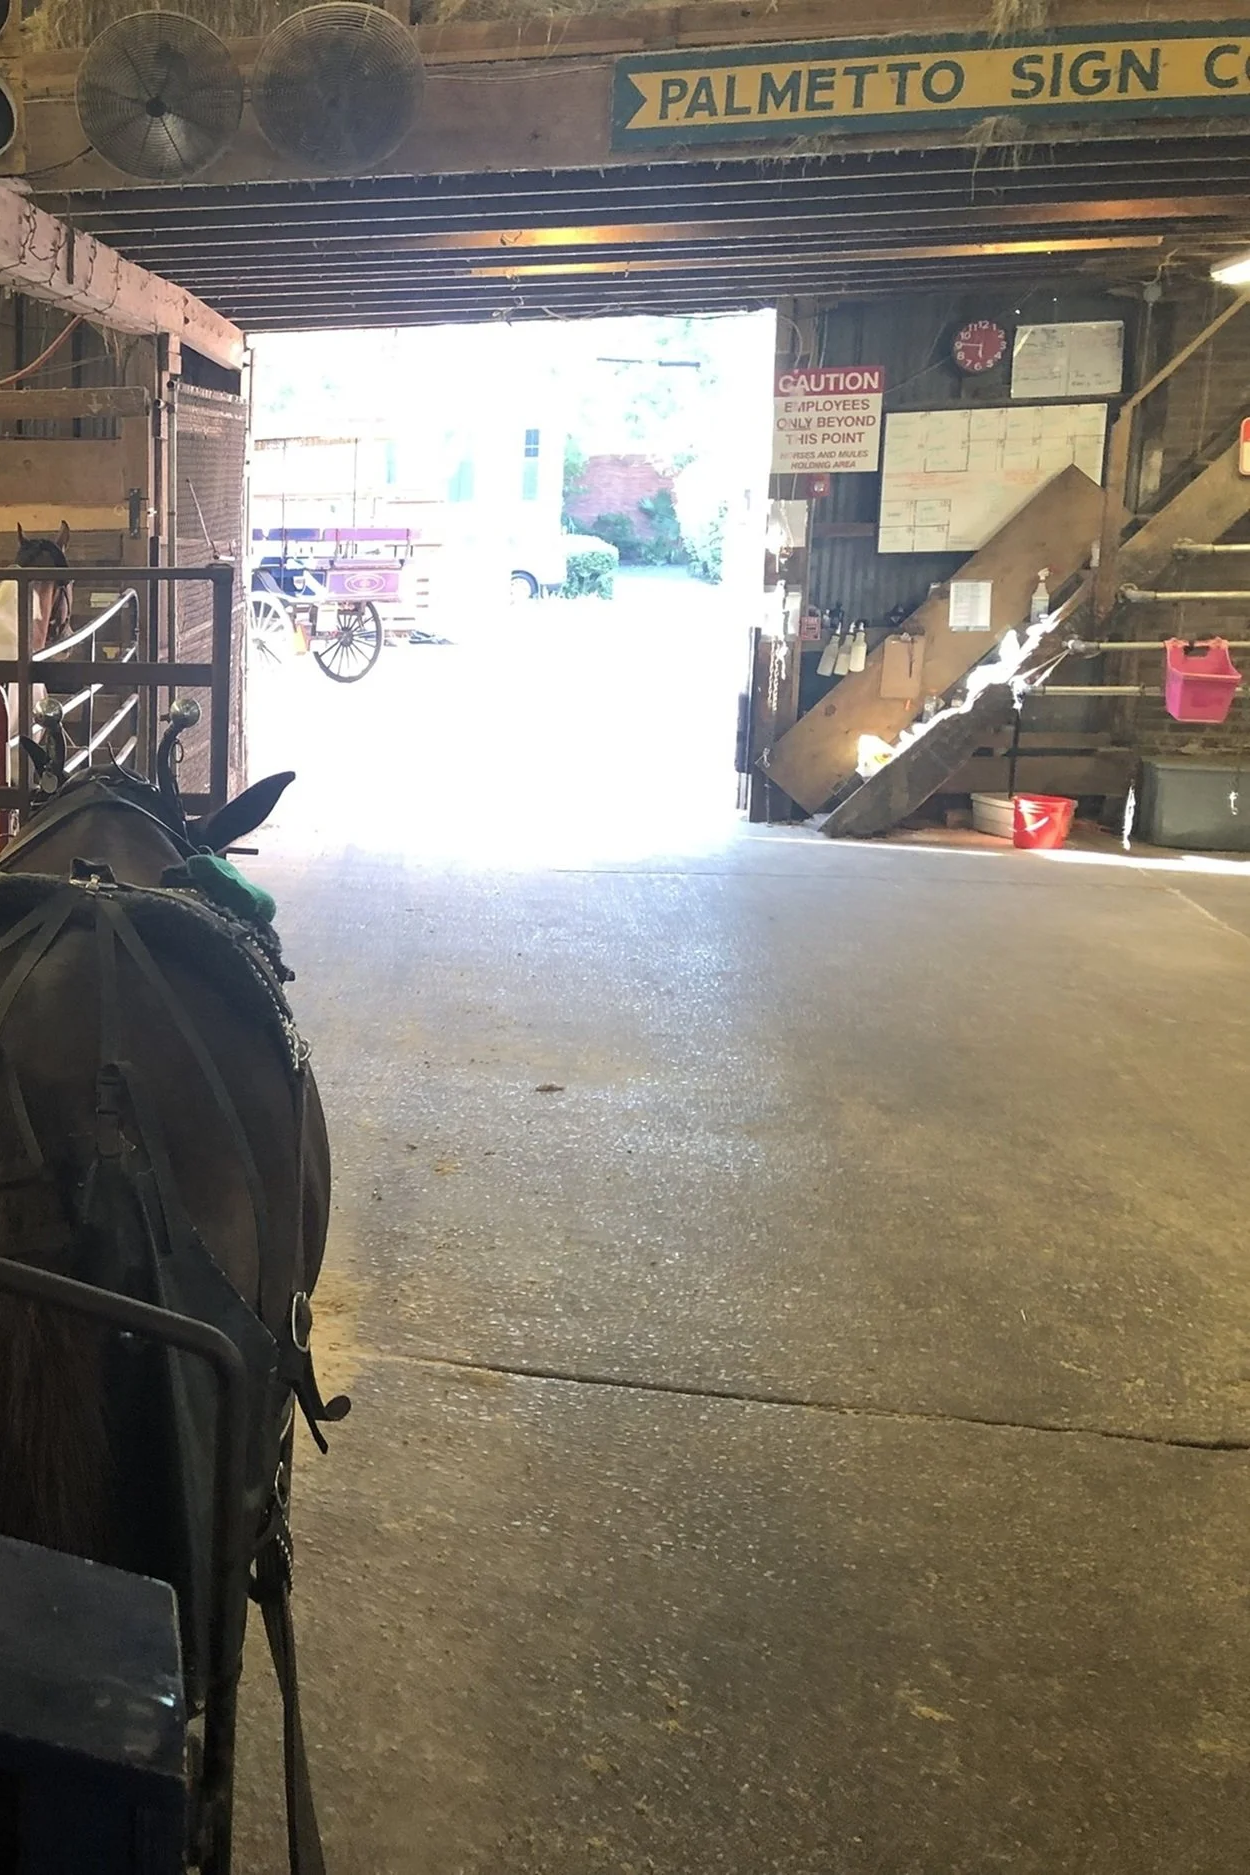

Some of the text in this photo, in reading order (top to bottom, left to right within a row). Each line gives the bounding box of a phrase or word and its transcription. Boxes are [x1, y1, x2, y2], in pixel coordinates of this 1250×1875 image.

[659, 59, 965, 120] PALMETTO
[1010, 47, 1161, 99] SIGN
[779, 372, 879, 393] CAUTION
[777, 415, 876, 431] ONLY BEYOND
[821, 432, 865, 444] POINT
[780, 450, 868, 460] HRSES AND MULES
[791, 460, 856, 470] HOLDING AREA
